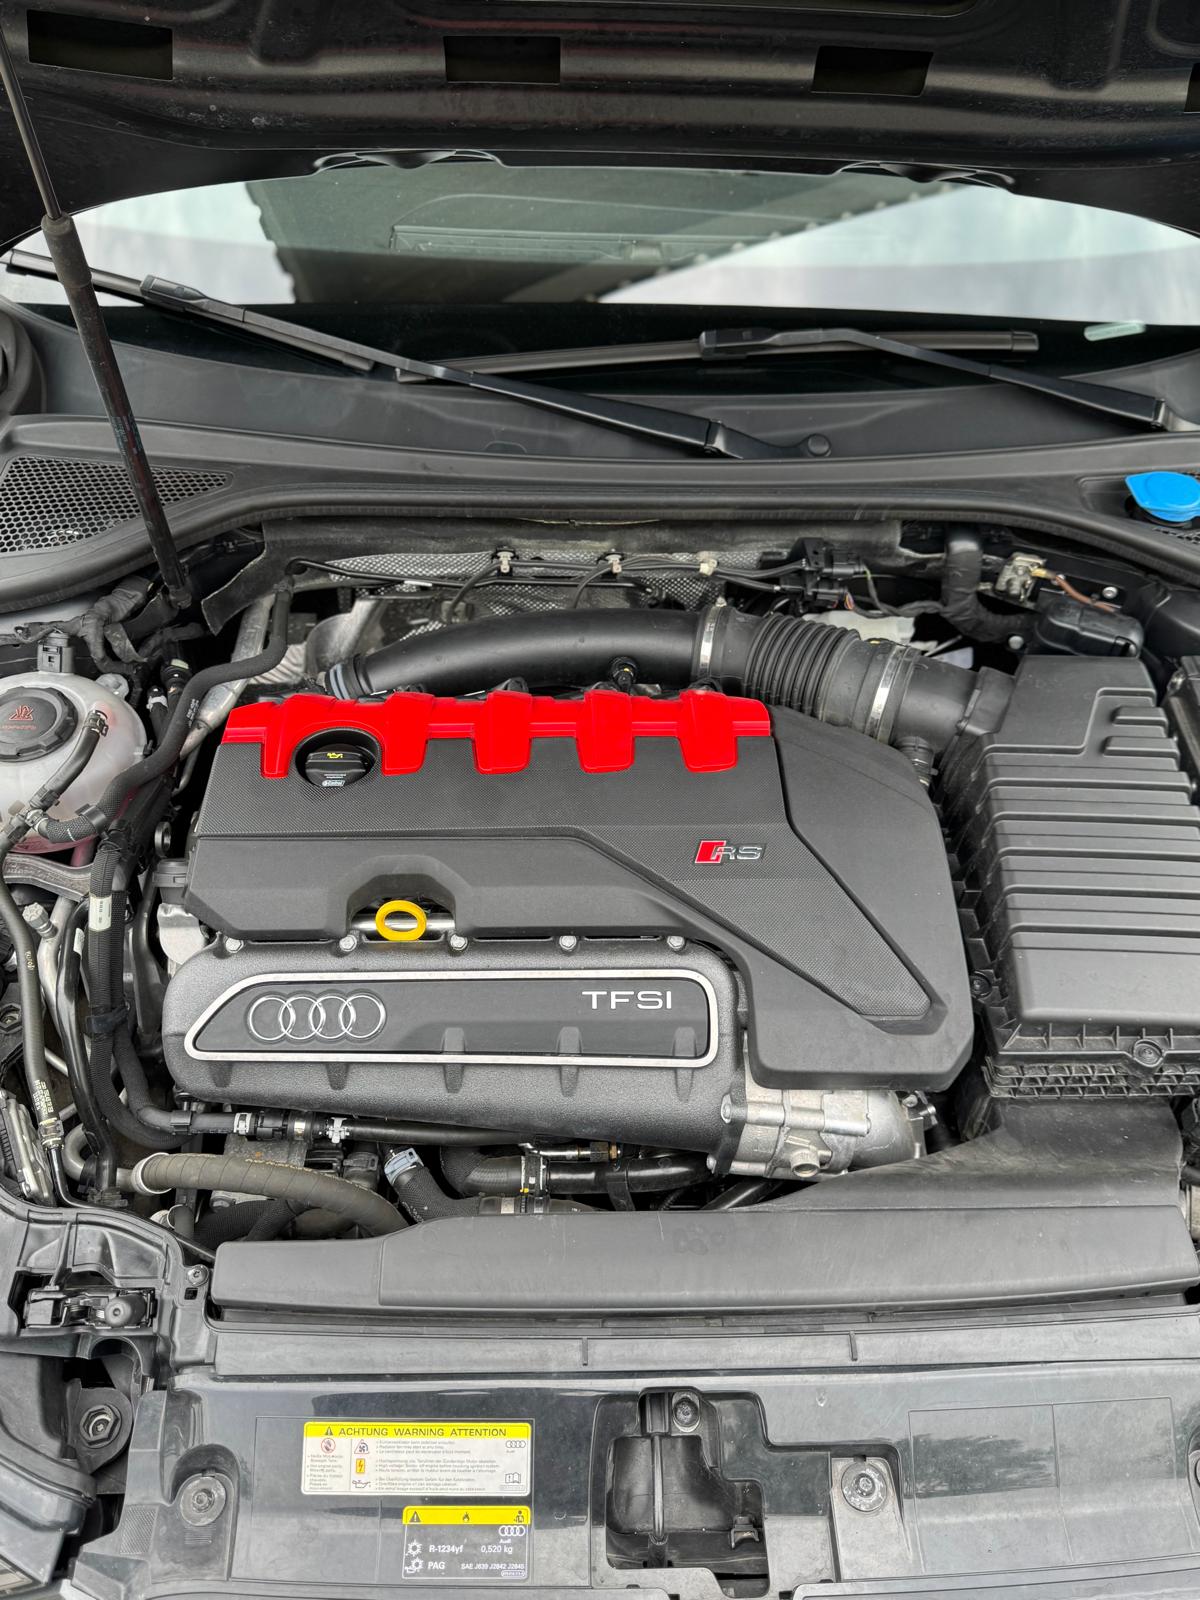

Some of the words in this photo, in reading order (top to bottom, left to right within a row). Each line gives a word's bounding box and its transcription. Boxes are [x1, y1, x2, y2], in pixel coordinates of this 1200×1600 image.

[709, 845, 763, 860] RS
[581, 990, 672, 1010] TFSI
[338, 1427, 388, 1436] ACHTUNG
[394, 1428, 445, 1437] WARNING
[450, 1428, 507, 1437] ATTENTION
[428, 1545, 464, 1555] R-1234yf
[480, 1545, 502, 1554] 0,520
[503, 1545, 514, 1555] kg
[427, 1561, 446, 1570] PAG
